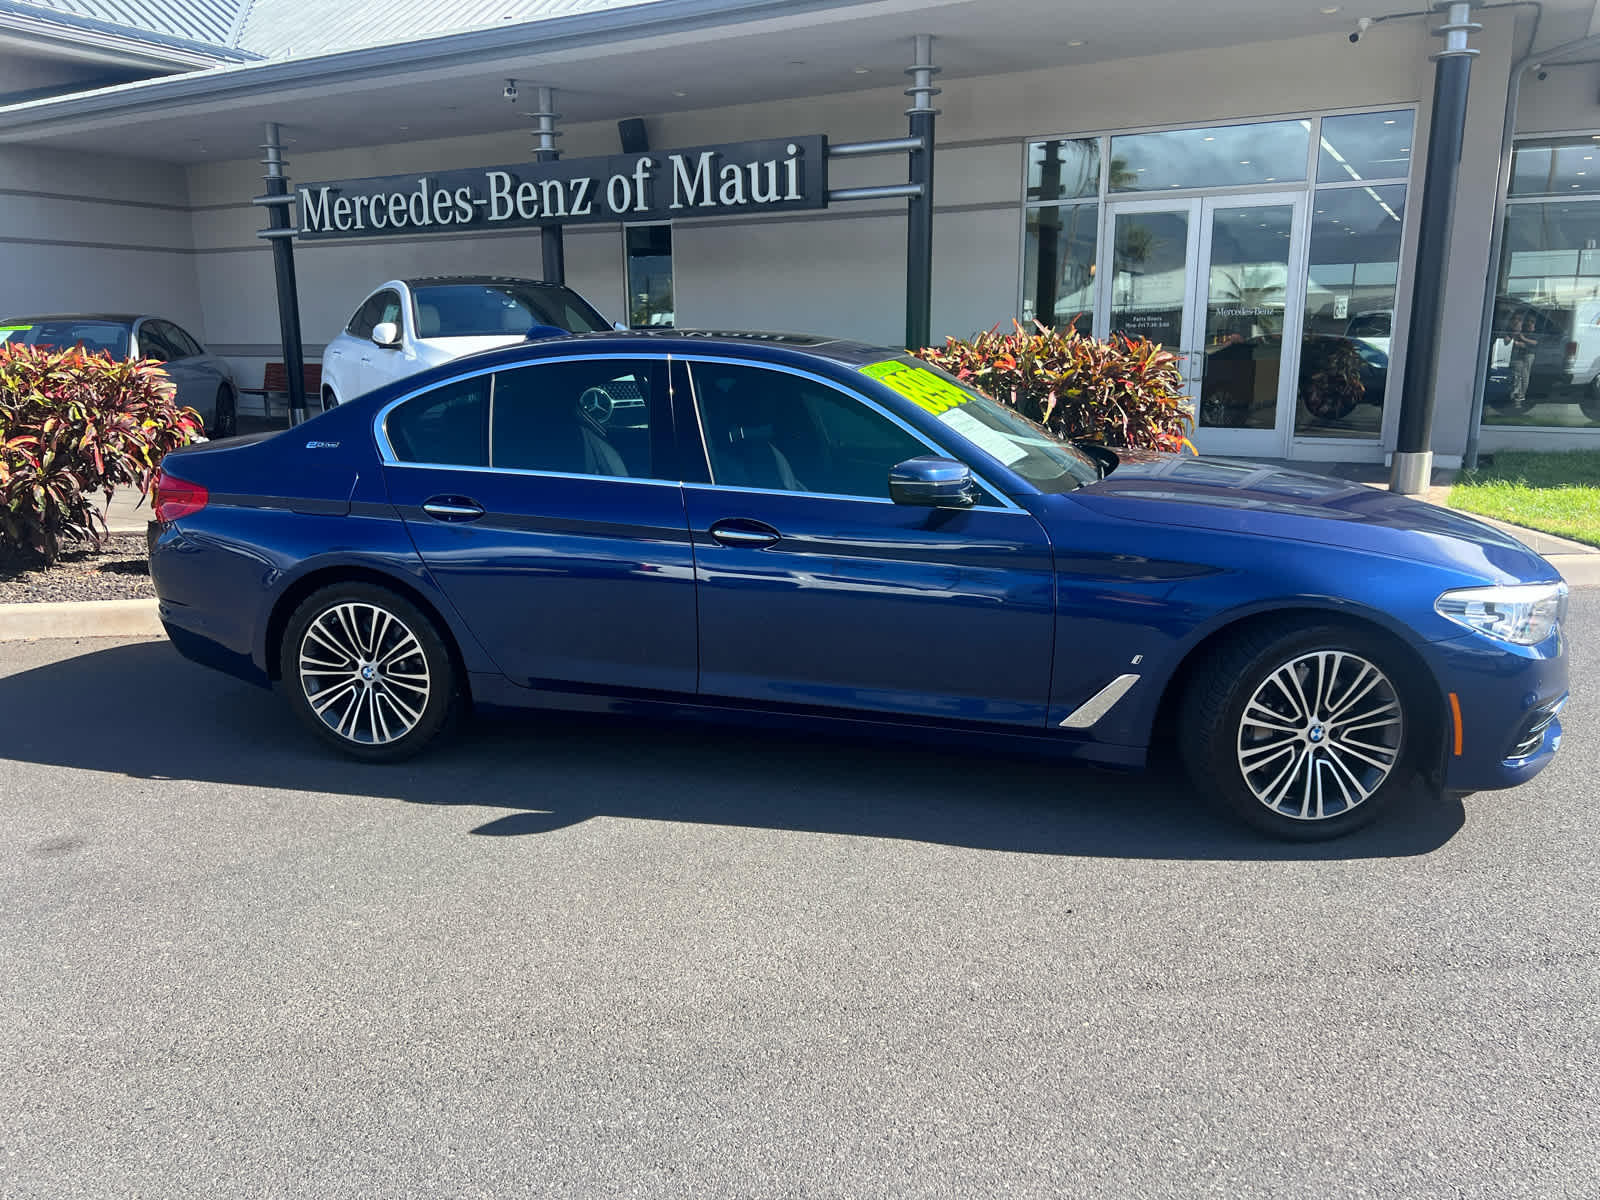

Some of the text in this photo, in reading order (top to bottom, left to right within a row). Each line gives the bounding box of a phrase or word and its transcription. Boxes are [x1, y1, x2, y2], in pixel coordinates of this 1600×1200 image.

[300, 143, 803, 233] Mercedes-Benz of Maui
